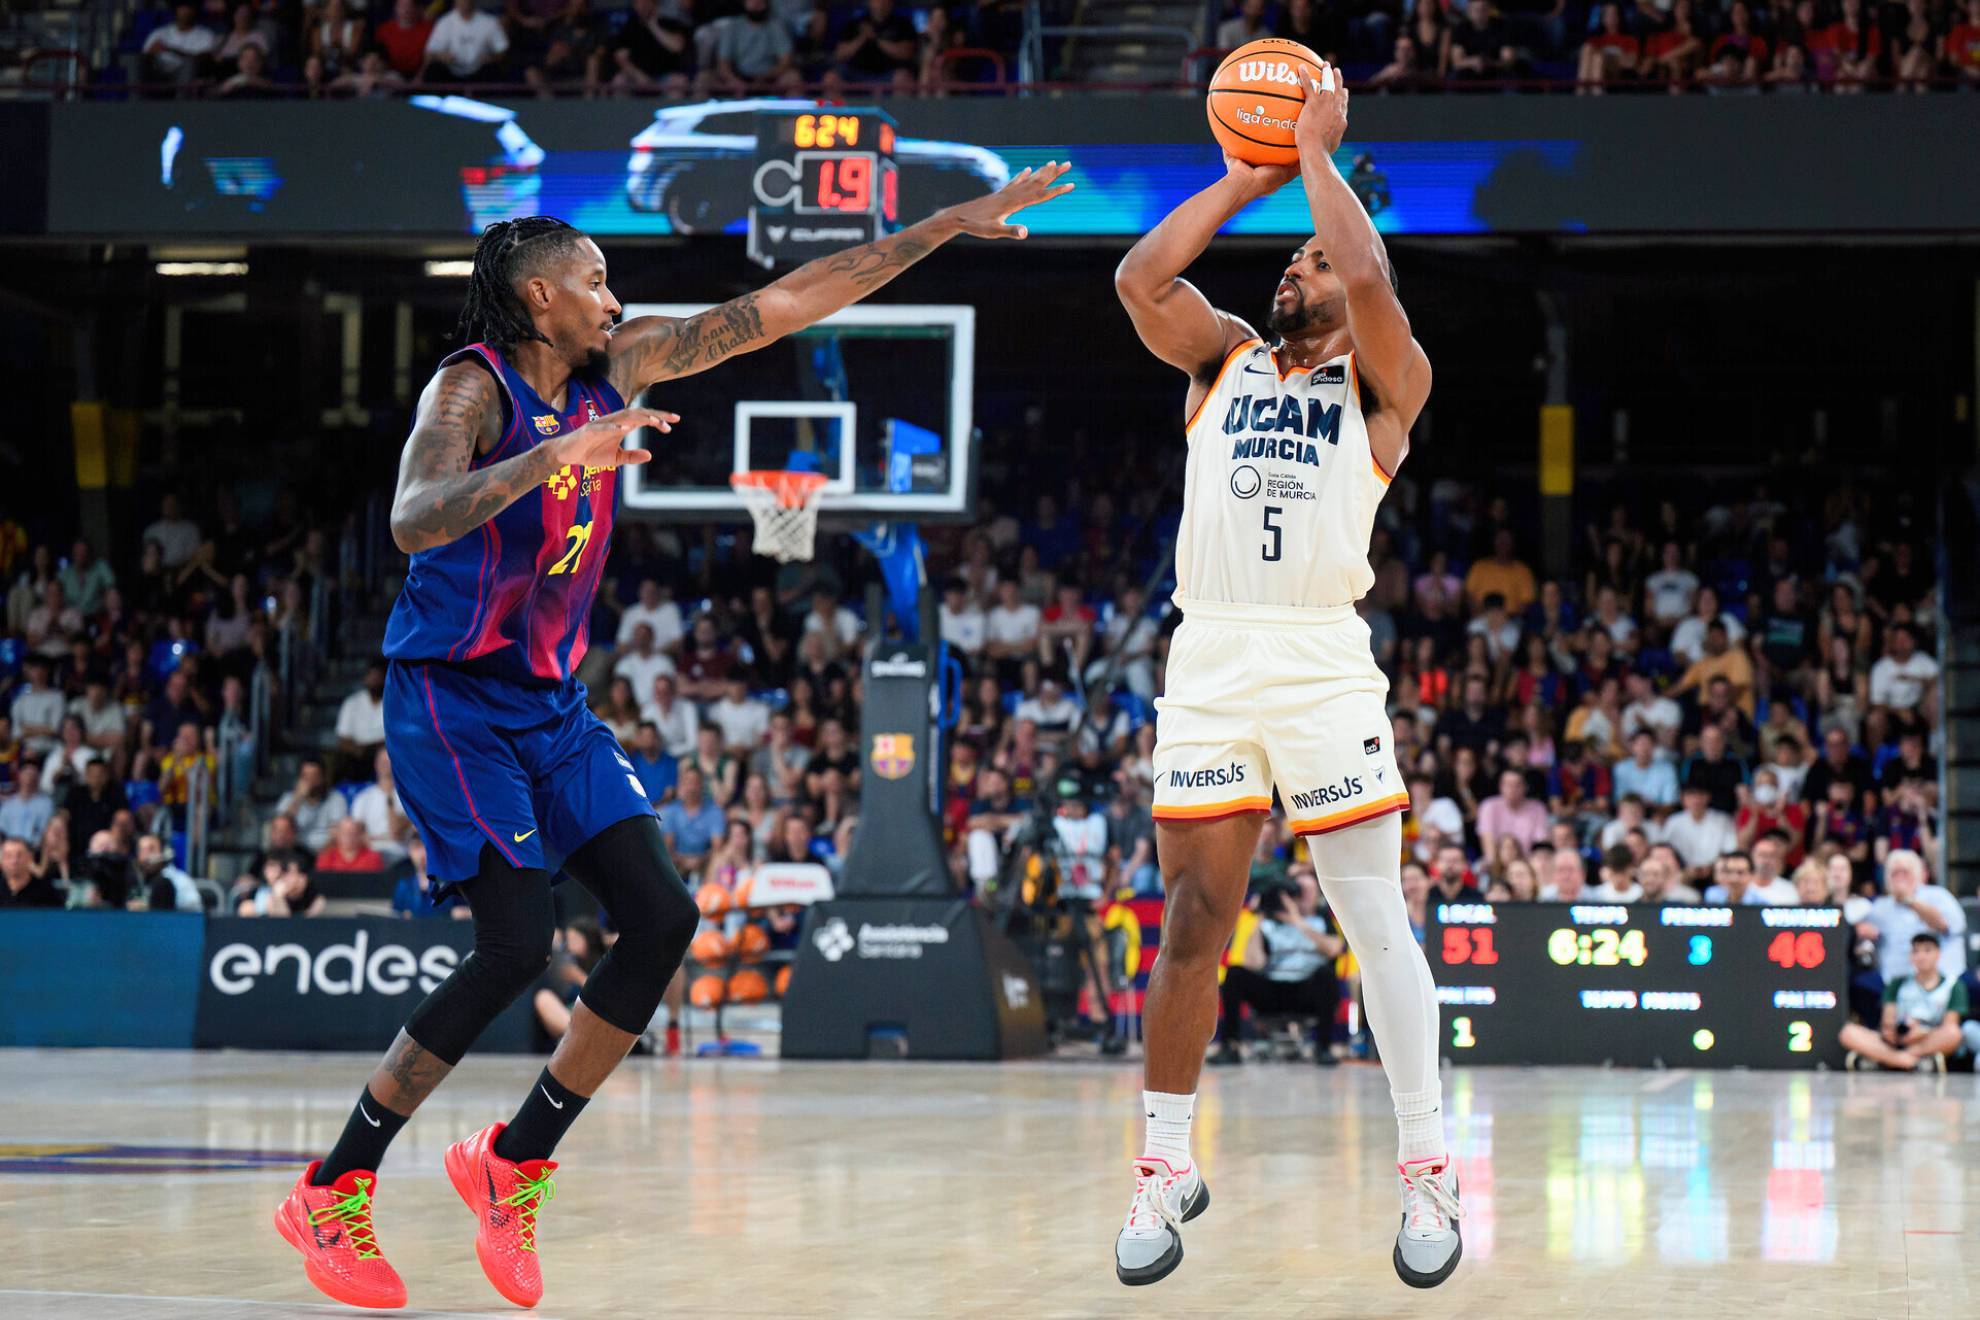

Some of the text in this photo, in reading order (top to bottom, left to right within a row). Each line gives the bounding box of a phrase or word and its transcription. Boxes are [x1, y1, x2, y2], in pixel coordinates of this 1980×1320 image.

[1238, 61, 1322, 96] Wilsn
[1236, 107, 1261, 124] liga
[1222, 394, 1343, 446] UCAM
[1231, 437, 1320, 467] MURCIA
[1266, 488, 1317, 500] DE MURCIA
[548, 520, 594, 575] 21
[1262, 505, 1283, 562] 5
[209, 929, 459, 996] endes
[1442, 927, 1499, 965] 51
[1548, 928, 1648, 967] 6:24
[1767, 931, 1826, 969] 46
[1452, 1016, 1476, 1048] 1
[1788, 1020, 1813, 1052] 2
